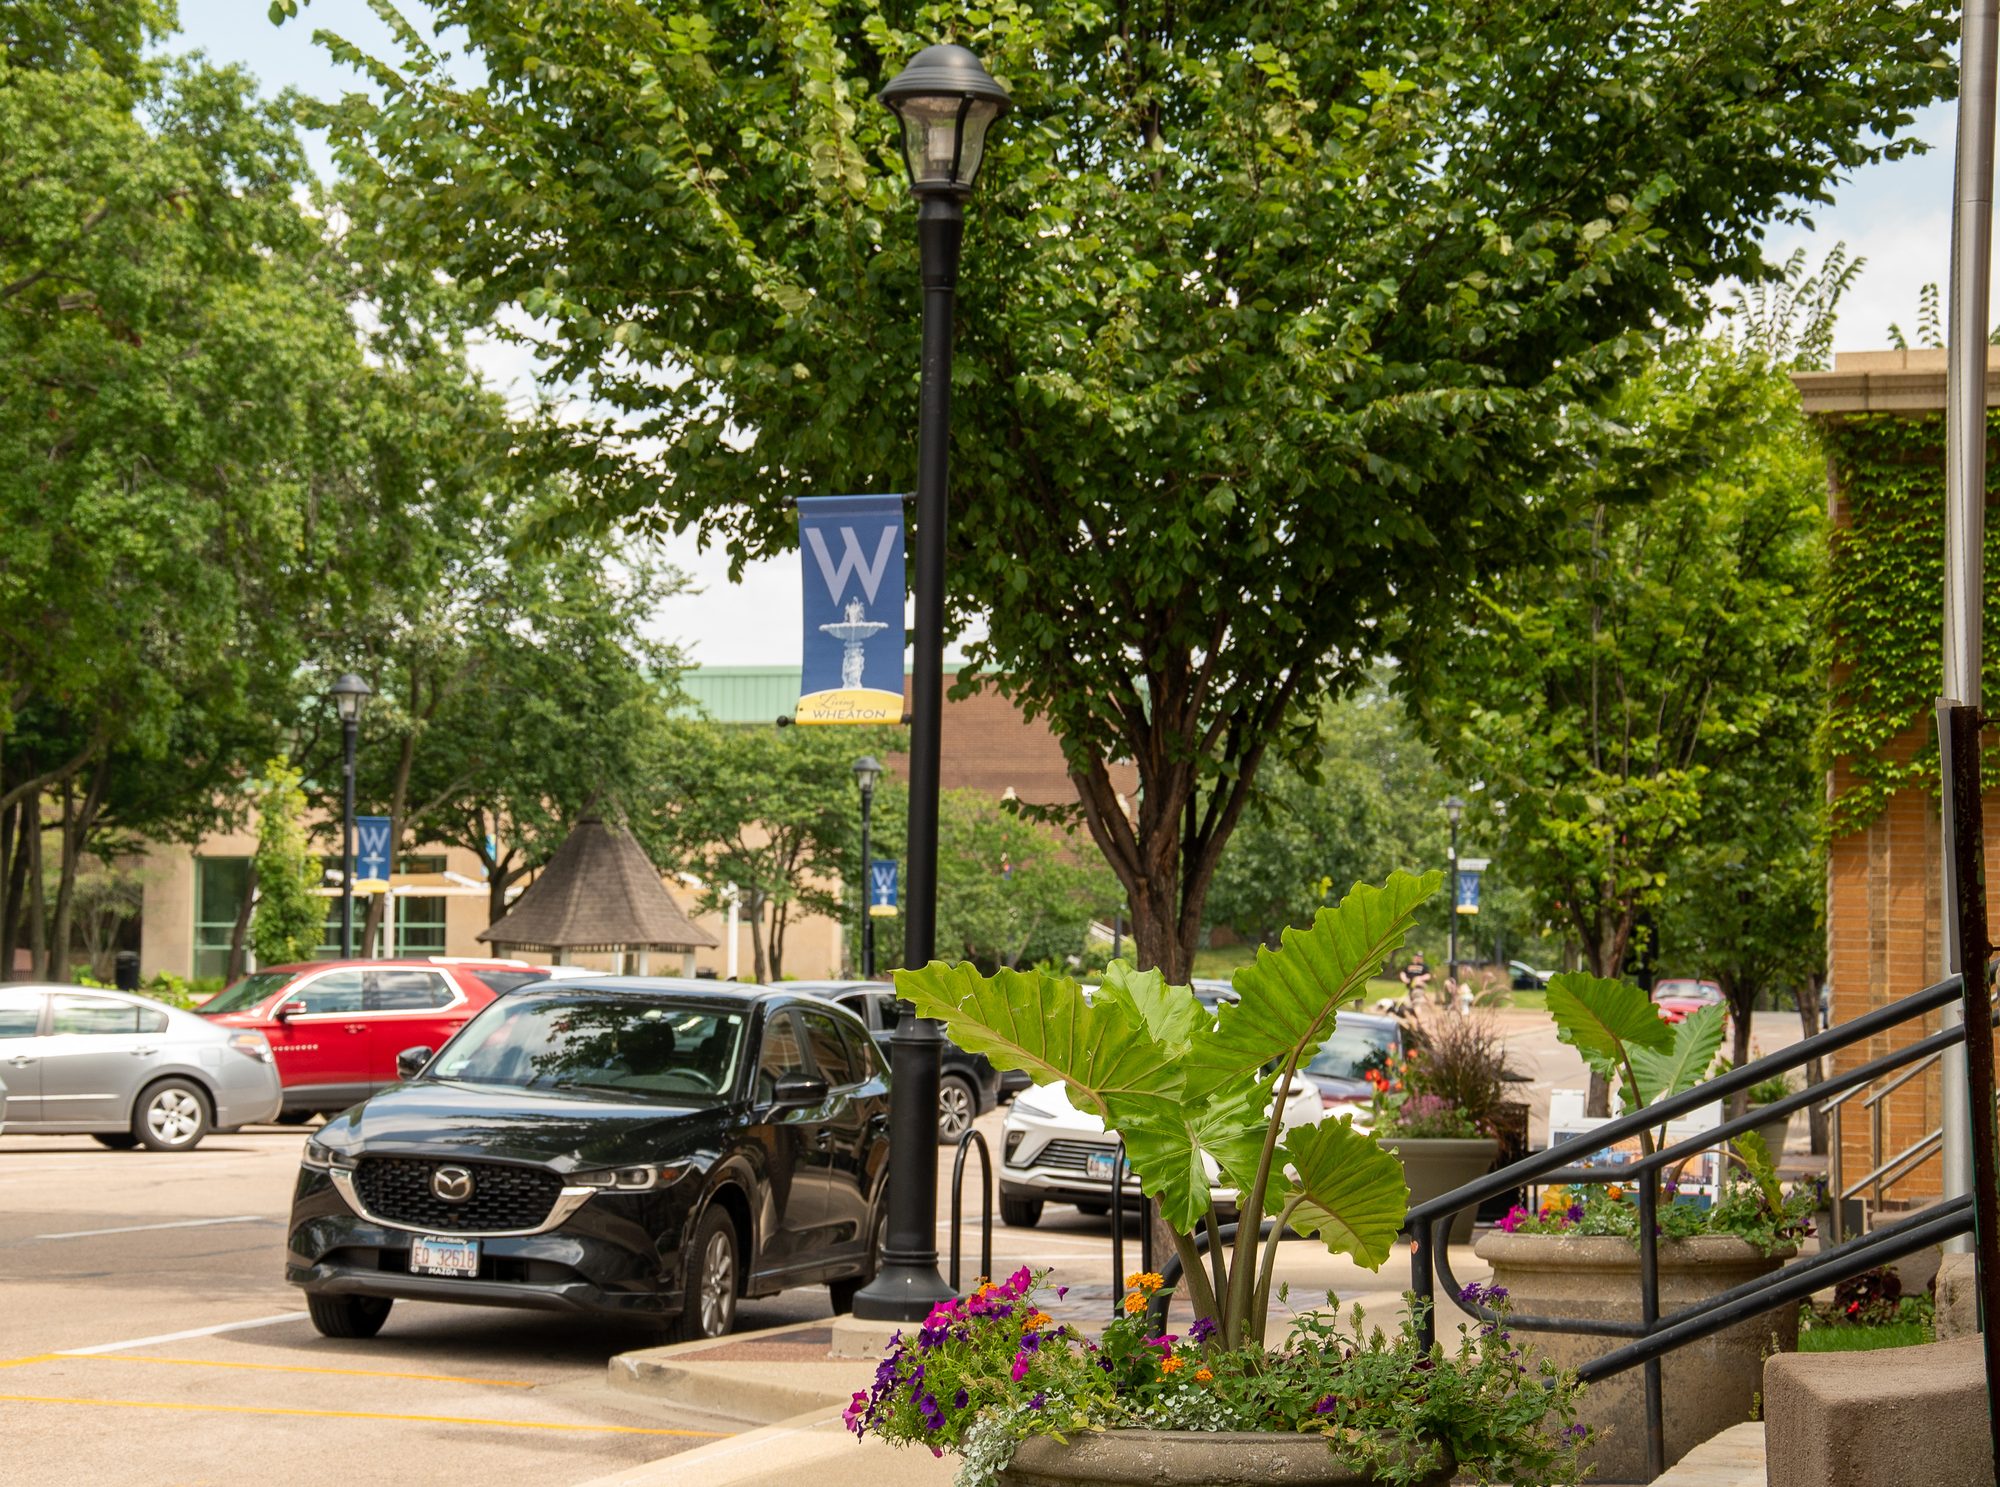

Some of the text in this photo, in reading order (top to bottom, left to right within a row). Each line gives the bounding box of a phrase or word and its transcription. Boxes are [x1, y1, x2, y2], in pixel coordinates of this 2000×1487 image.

[804, 525, 899, 607] W
[816, 693, 855, 709] Living
[813, 708, 887, 719] WHEATON
[359, 826, 389, 853] W
[872, 867, 896, 888] W
[1460, 877, 1479, 892] W
[428, 1267, 459, 1276] MAZDA
